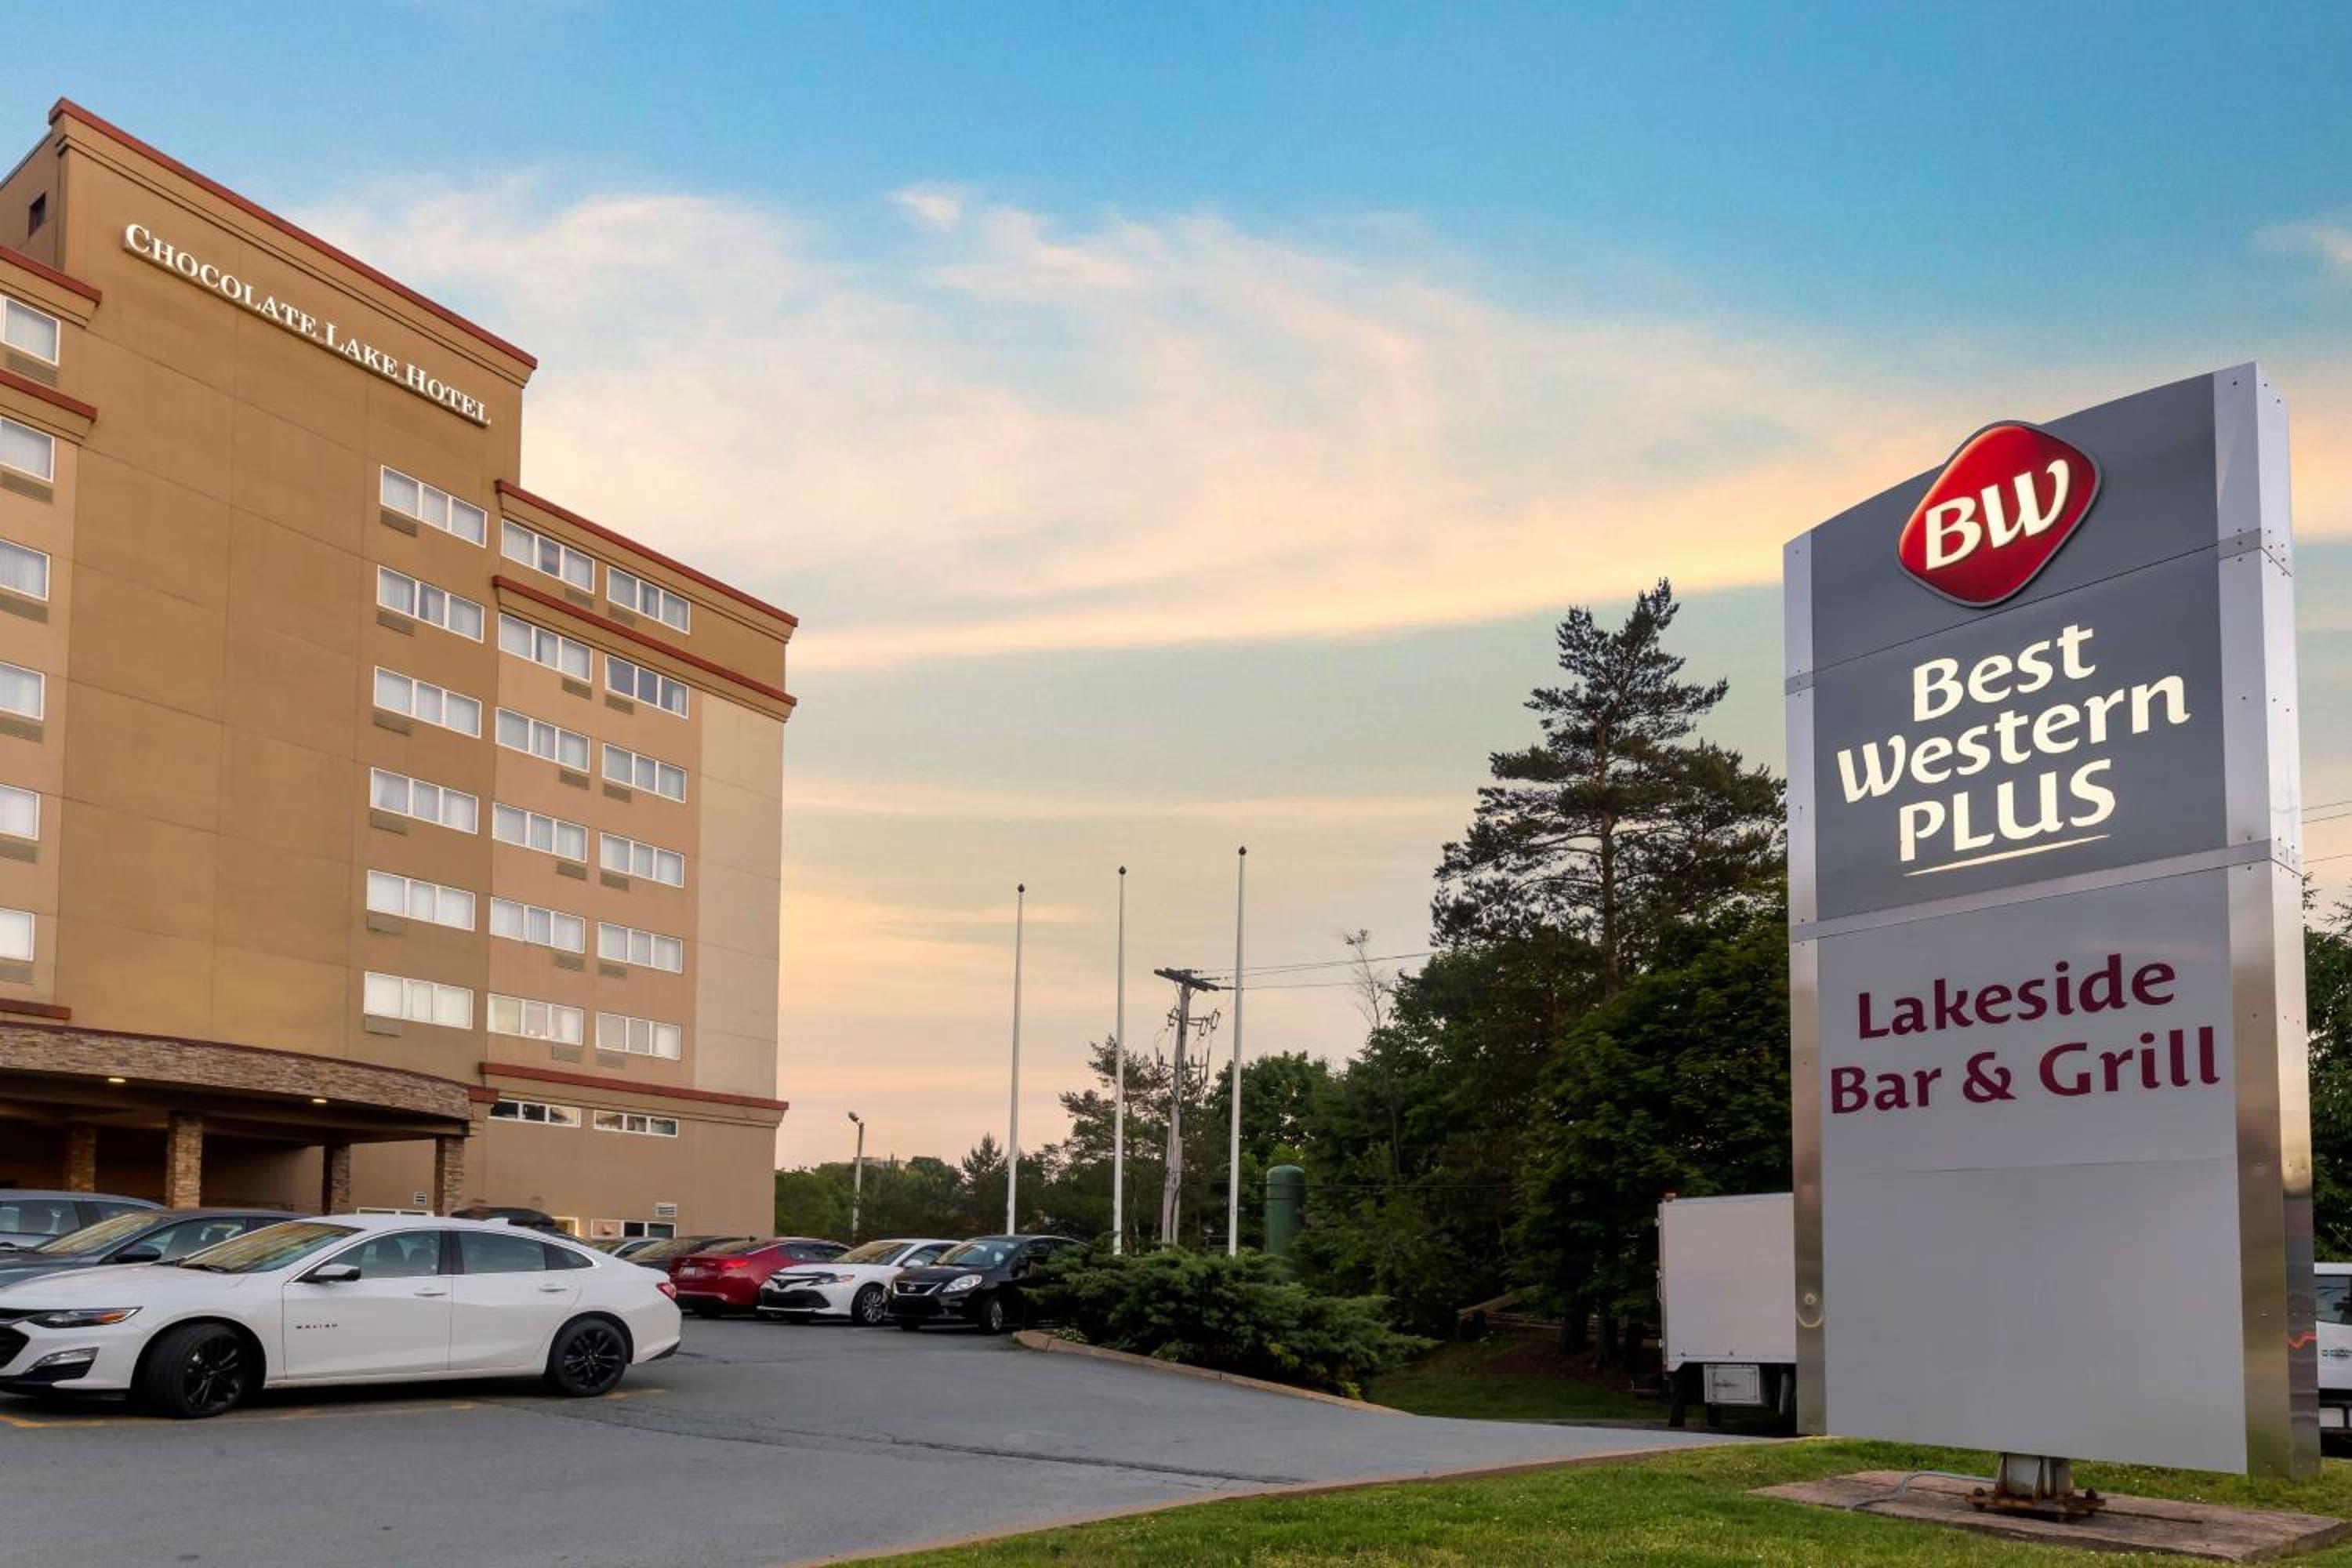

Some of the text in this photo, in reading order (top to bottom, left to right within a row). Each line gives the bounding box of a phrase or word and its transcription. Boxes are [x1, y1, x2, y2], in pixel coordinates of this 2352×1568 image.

[125, 223, 492, 426] CHOCOLATE LAKE HOTEL
[1924, 459, 2070, 572] BW
[1912, 623, 2096, 723] Best
[1836, 674, 2192, 804] Western
[1898, 757, 2117, 863] PLUS
[1858, 953, 2176, 1040] Lakeside
[1831, 1025, 2221, 1115] Bar & Grill
